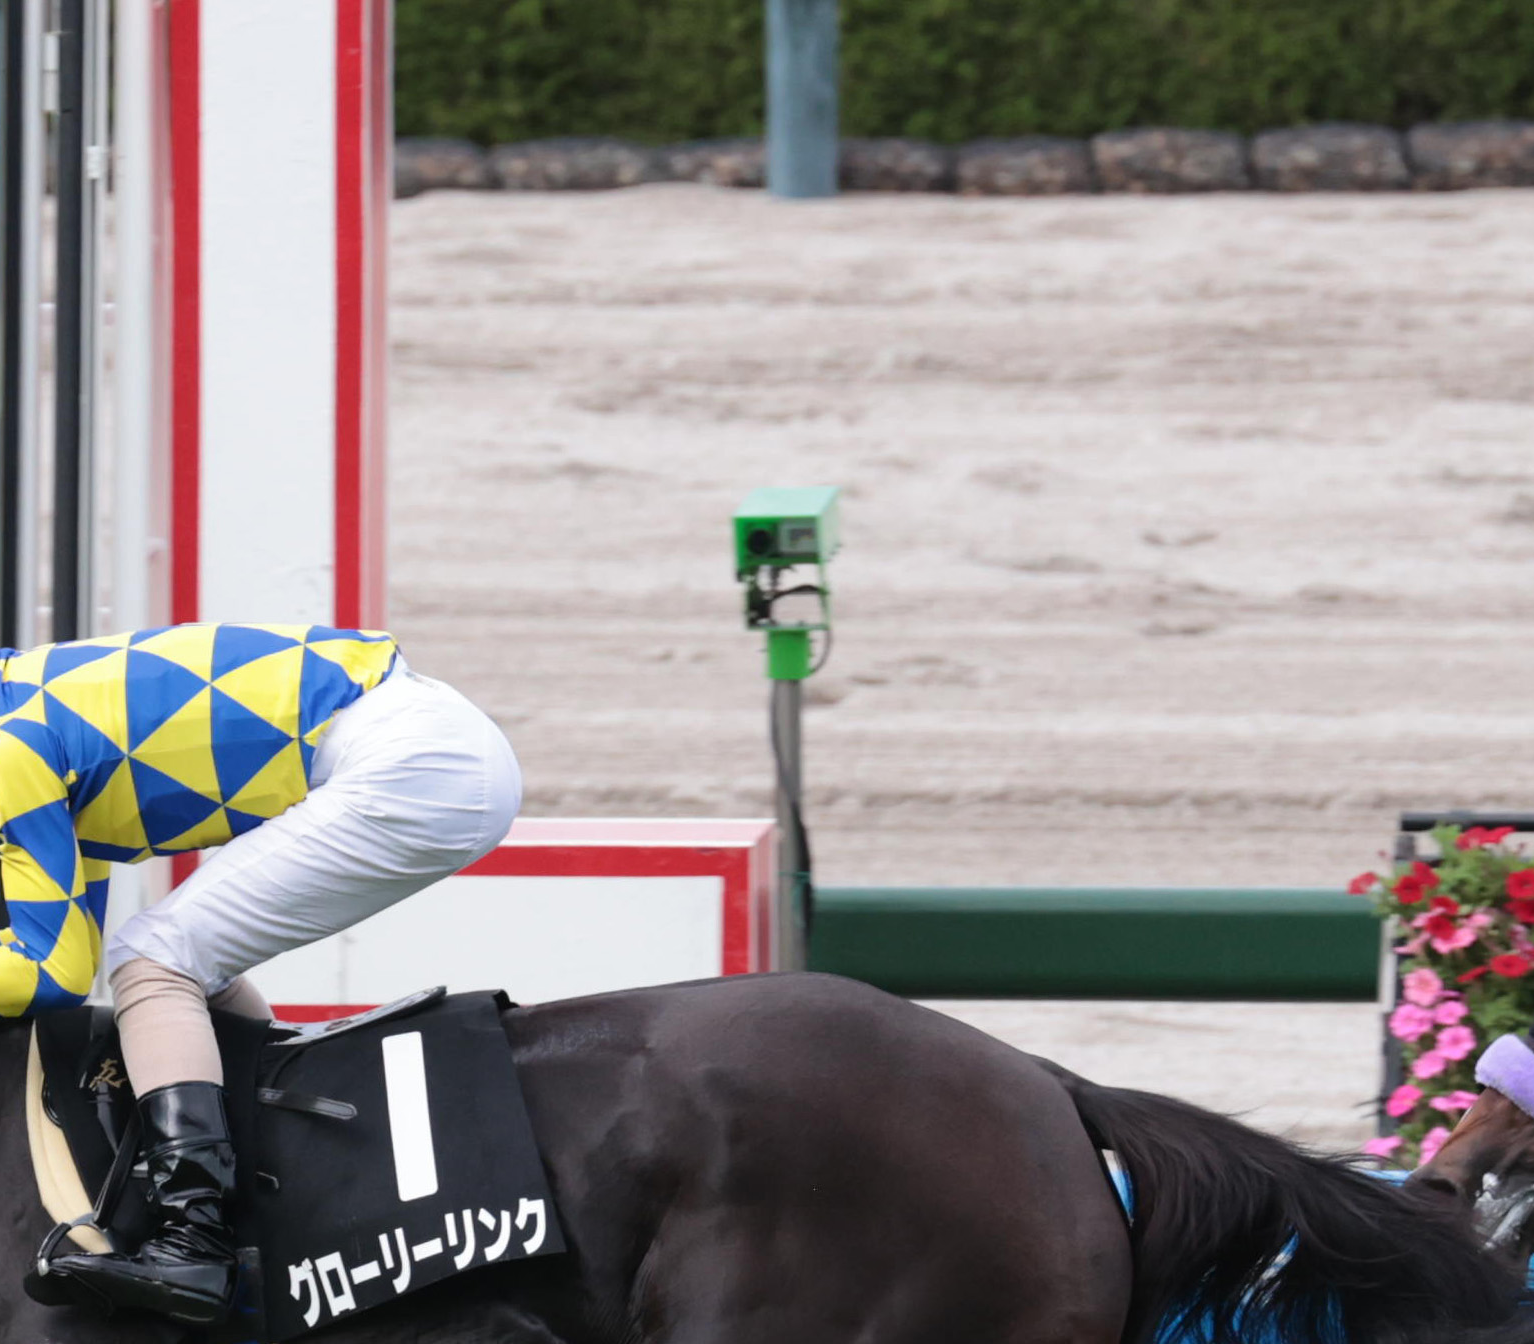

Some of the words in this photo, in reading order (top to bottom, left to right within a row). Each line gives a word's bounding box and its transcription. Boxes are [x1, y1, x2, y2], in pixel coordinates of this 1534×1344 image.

[381, 1031, 439, 1202] 1
[287, 1197, 548, 1328] グローリーリンク
